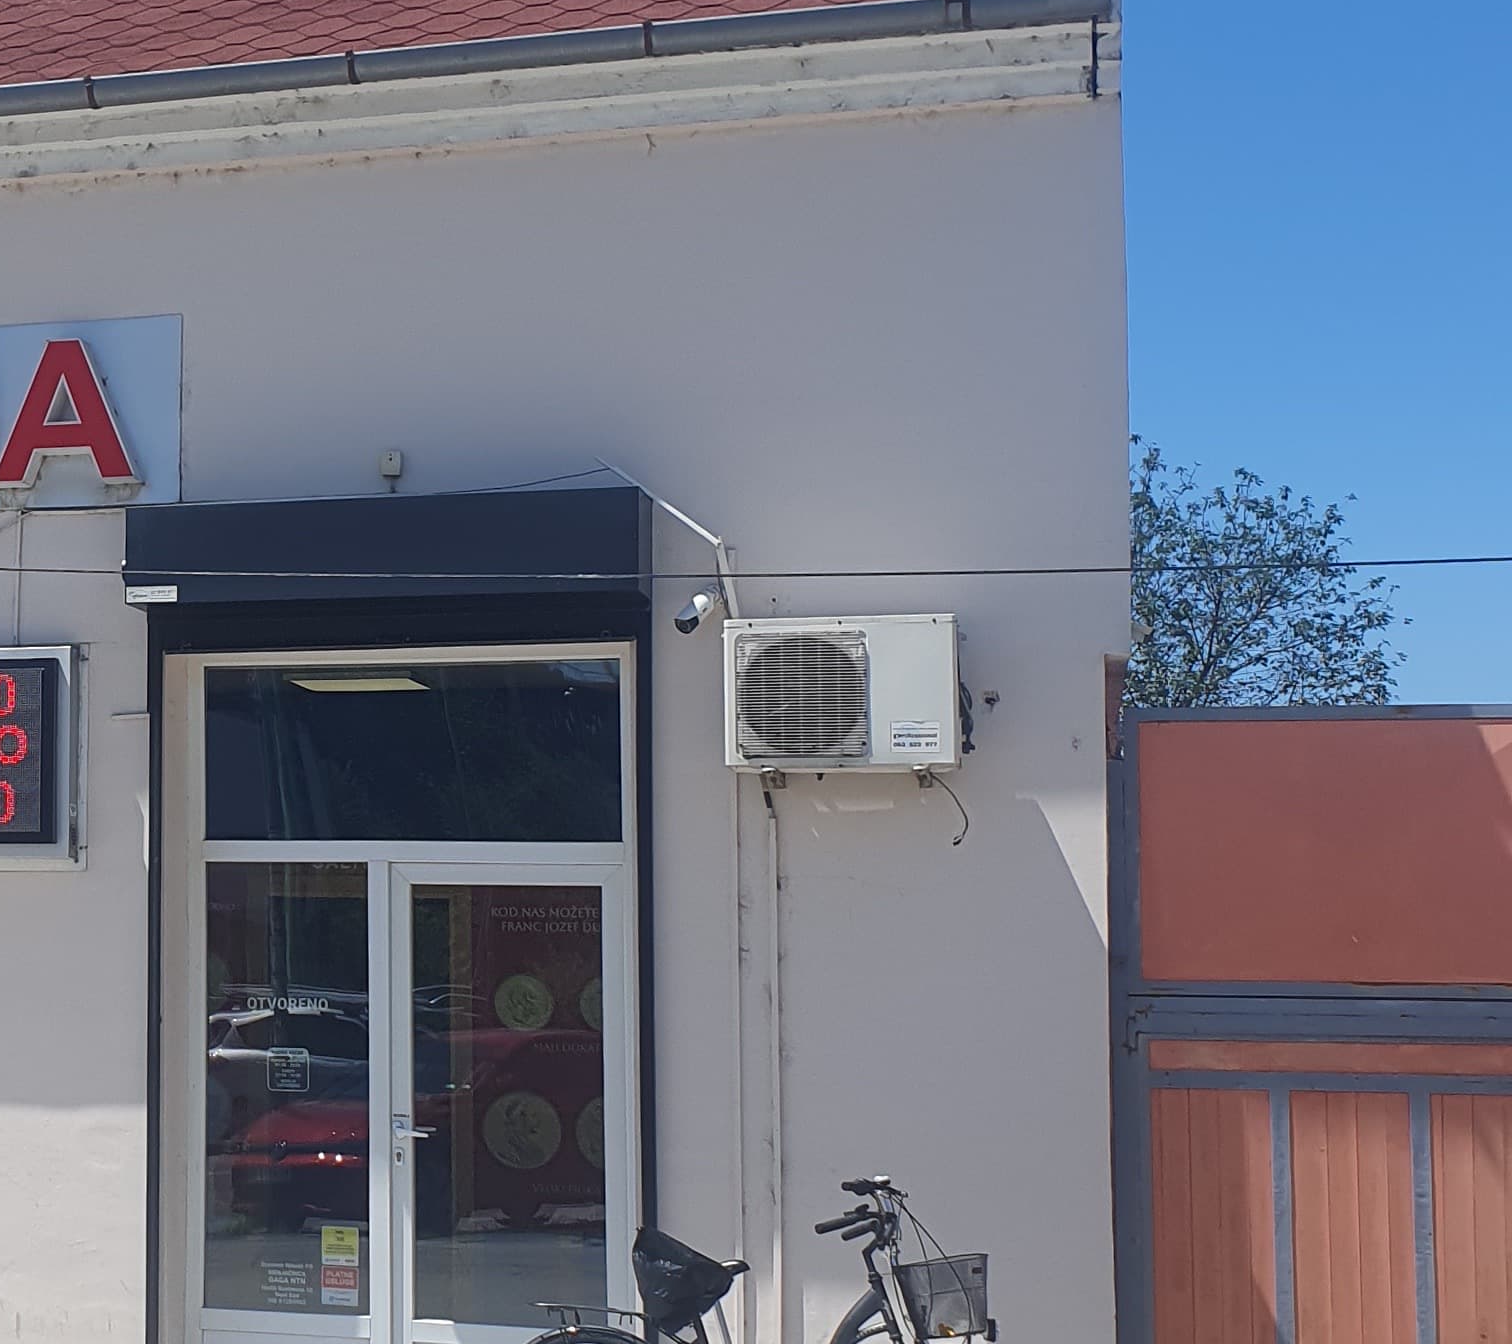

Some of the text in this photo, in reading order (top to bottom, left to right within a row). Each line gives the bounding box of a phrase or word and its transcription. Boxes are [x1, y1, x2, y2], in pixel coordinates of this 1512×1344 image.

[490, 904, 600, 919] KOD NAS MOŽETE
[501, 921, 542, 932] FRANC
[247, 996, 329, 1010] OTVORENO
